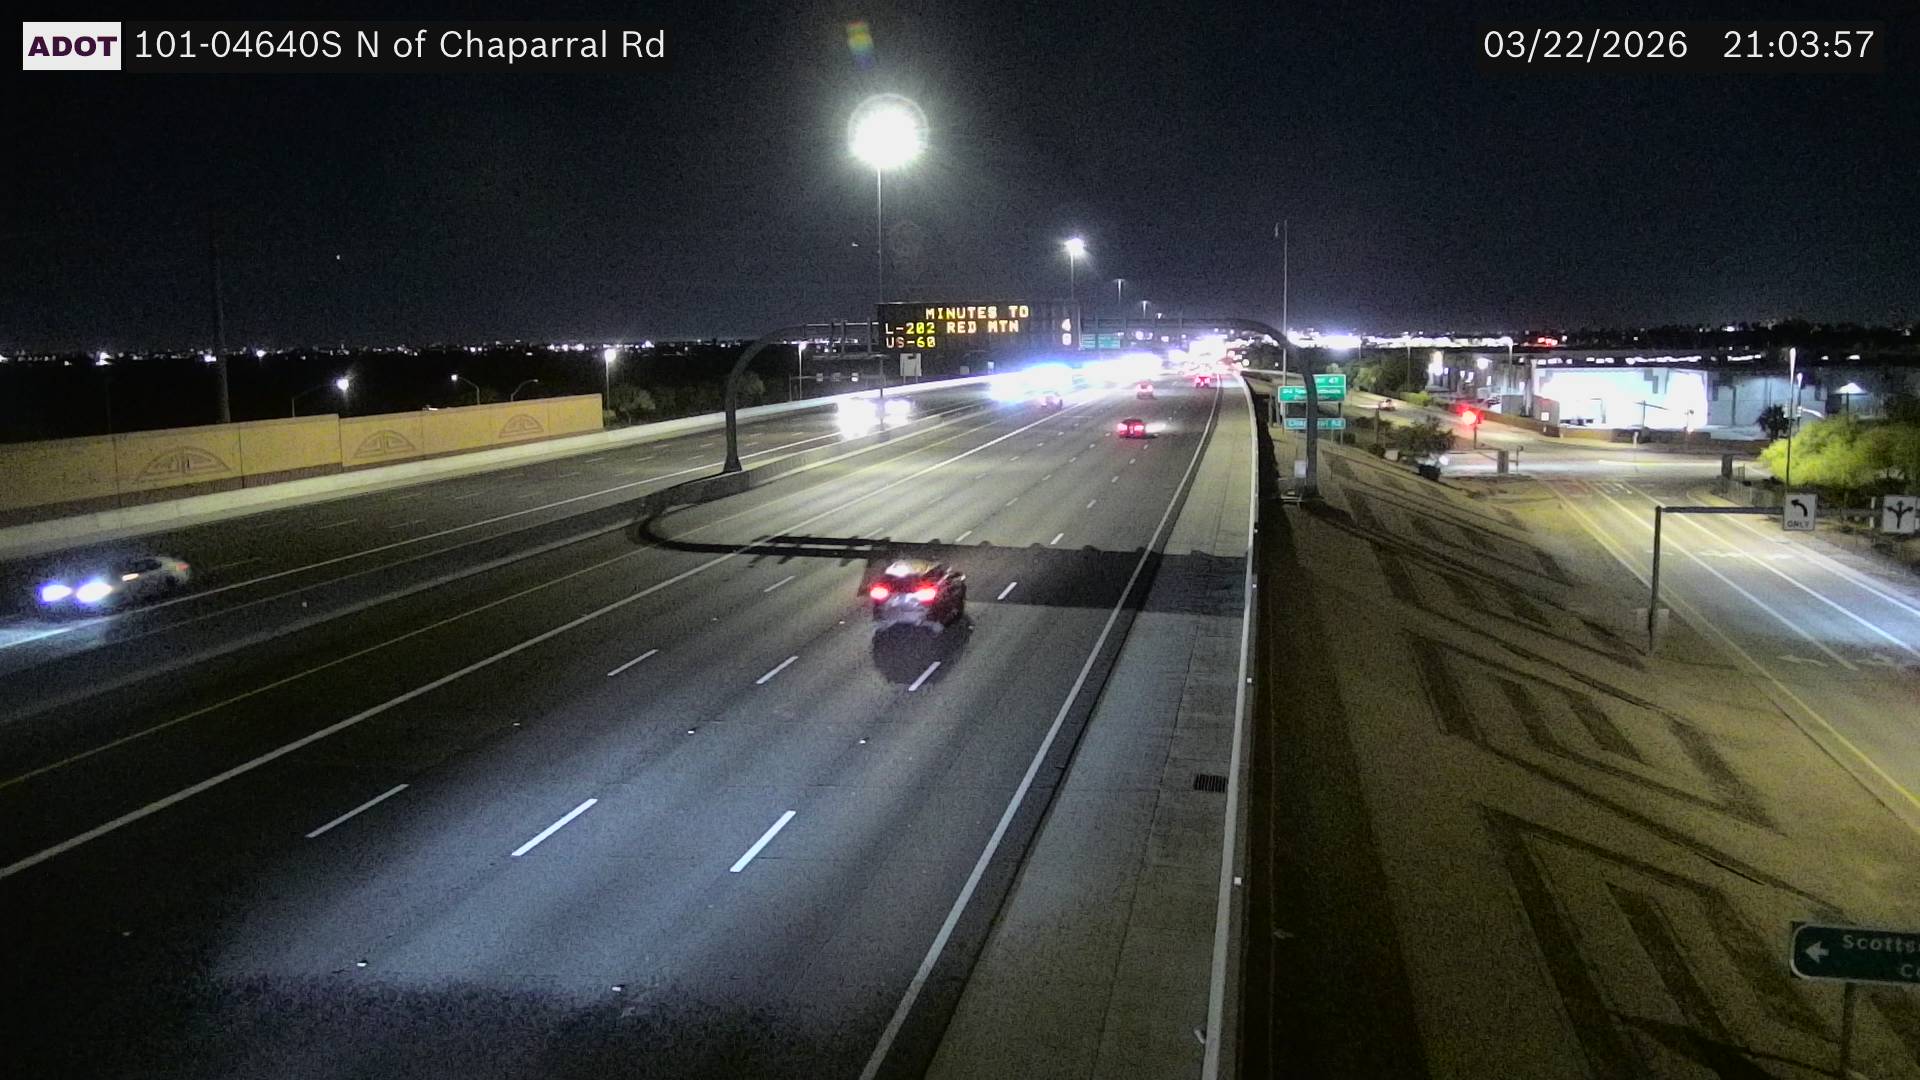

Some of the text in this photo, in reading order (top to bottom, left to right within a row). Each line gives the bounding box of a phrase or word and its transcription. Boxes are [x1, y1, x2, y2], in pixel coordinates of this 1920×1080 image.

[925, 305, 1029, 319] MINUTES TO
[885, 322, 936, 335] L-202
[946, 320, 978, 333] RED
[987, 319, 1019, 332] MTN
[886, 336, 936, 348] US-60
[1841, 933, 1920, 954] Scotts
[1900, 963, 1920, 979] C
